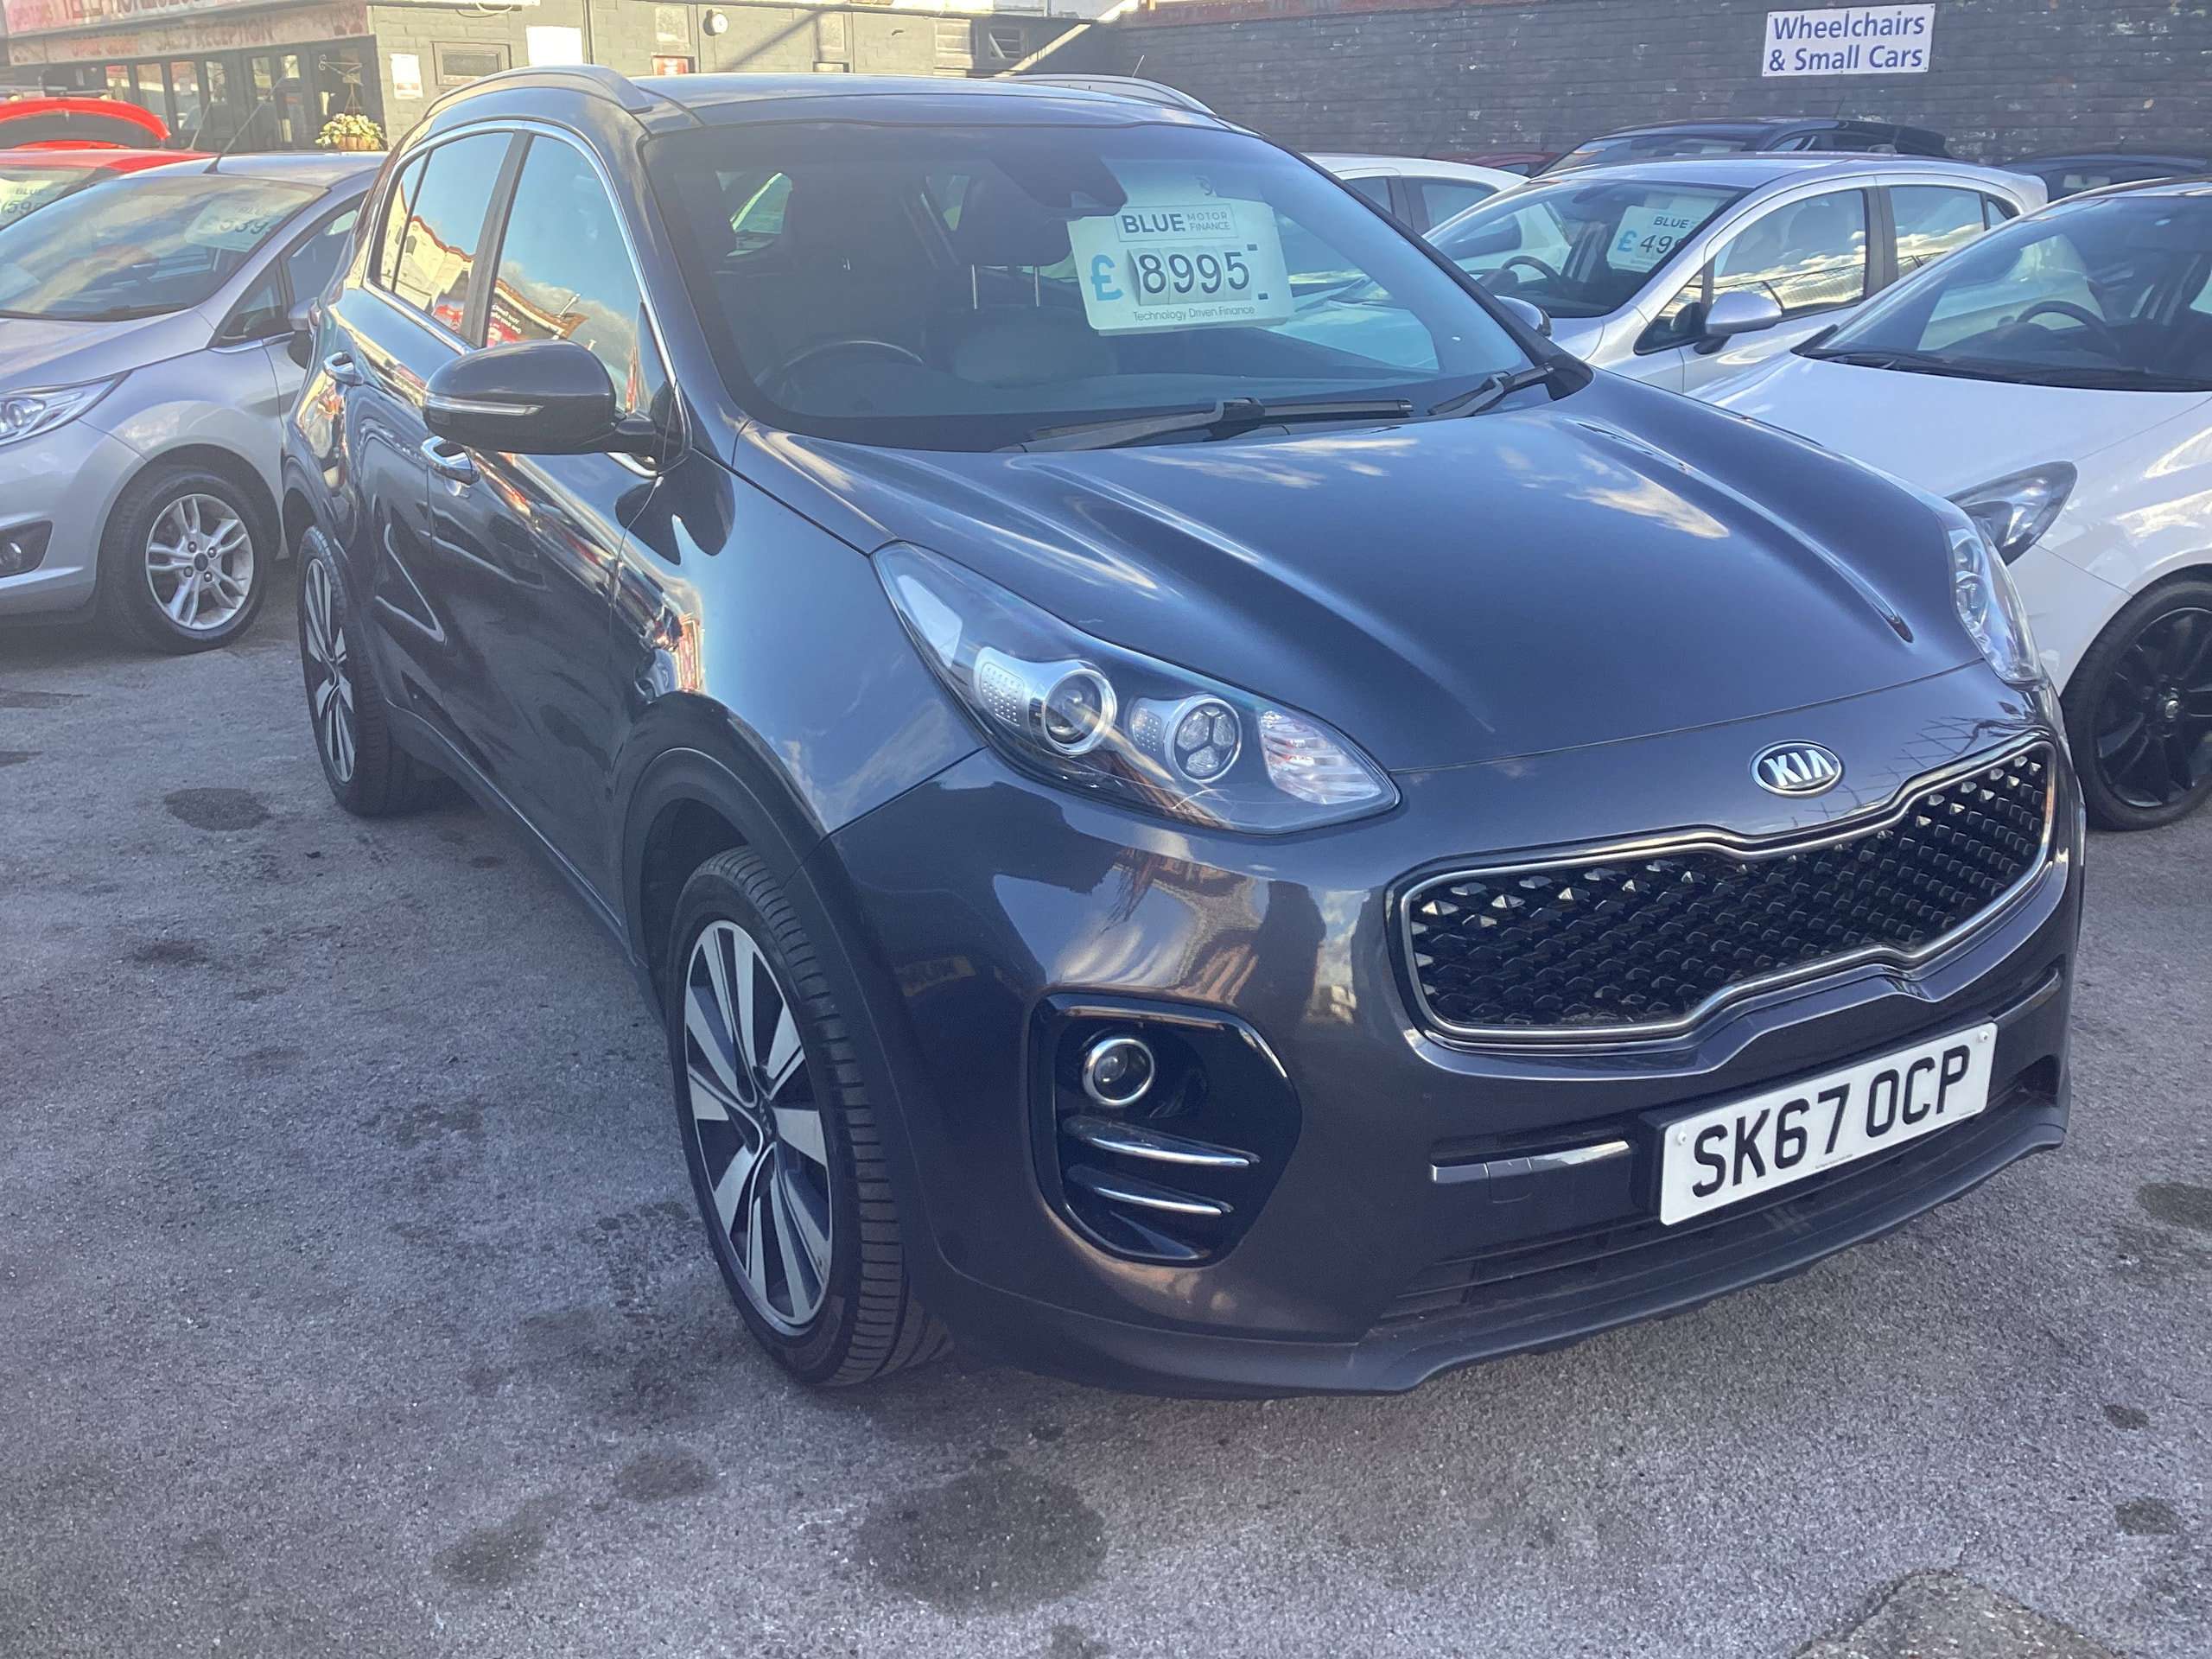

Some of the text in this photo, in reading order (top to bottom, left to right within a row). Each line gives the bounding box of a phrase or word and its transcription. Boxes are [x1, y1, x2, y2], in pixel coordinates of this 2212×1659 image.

[1774, 10, 1925, 40] Wheelchairs
[1769, 44, 1923, 72] & Small Cars
[1122, 212, 1228, 233] BLUE MOTOR
[1189, 221, 1231, 232] FINANCE
[1653, 216, 1689, 229] BLUE
[1639, 235, 1687, 255] 49
[1138, 251, 1249, 295] 8995
[1133, 304, 1255, 322] Technology Driven Finance
[1763, 749, 1835, 787] KIA
[1692, 1044, 1971, 1198] SK67 OCP
